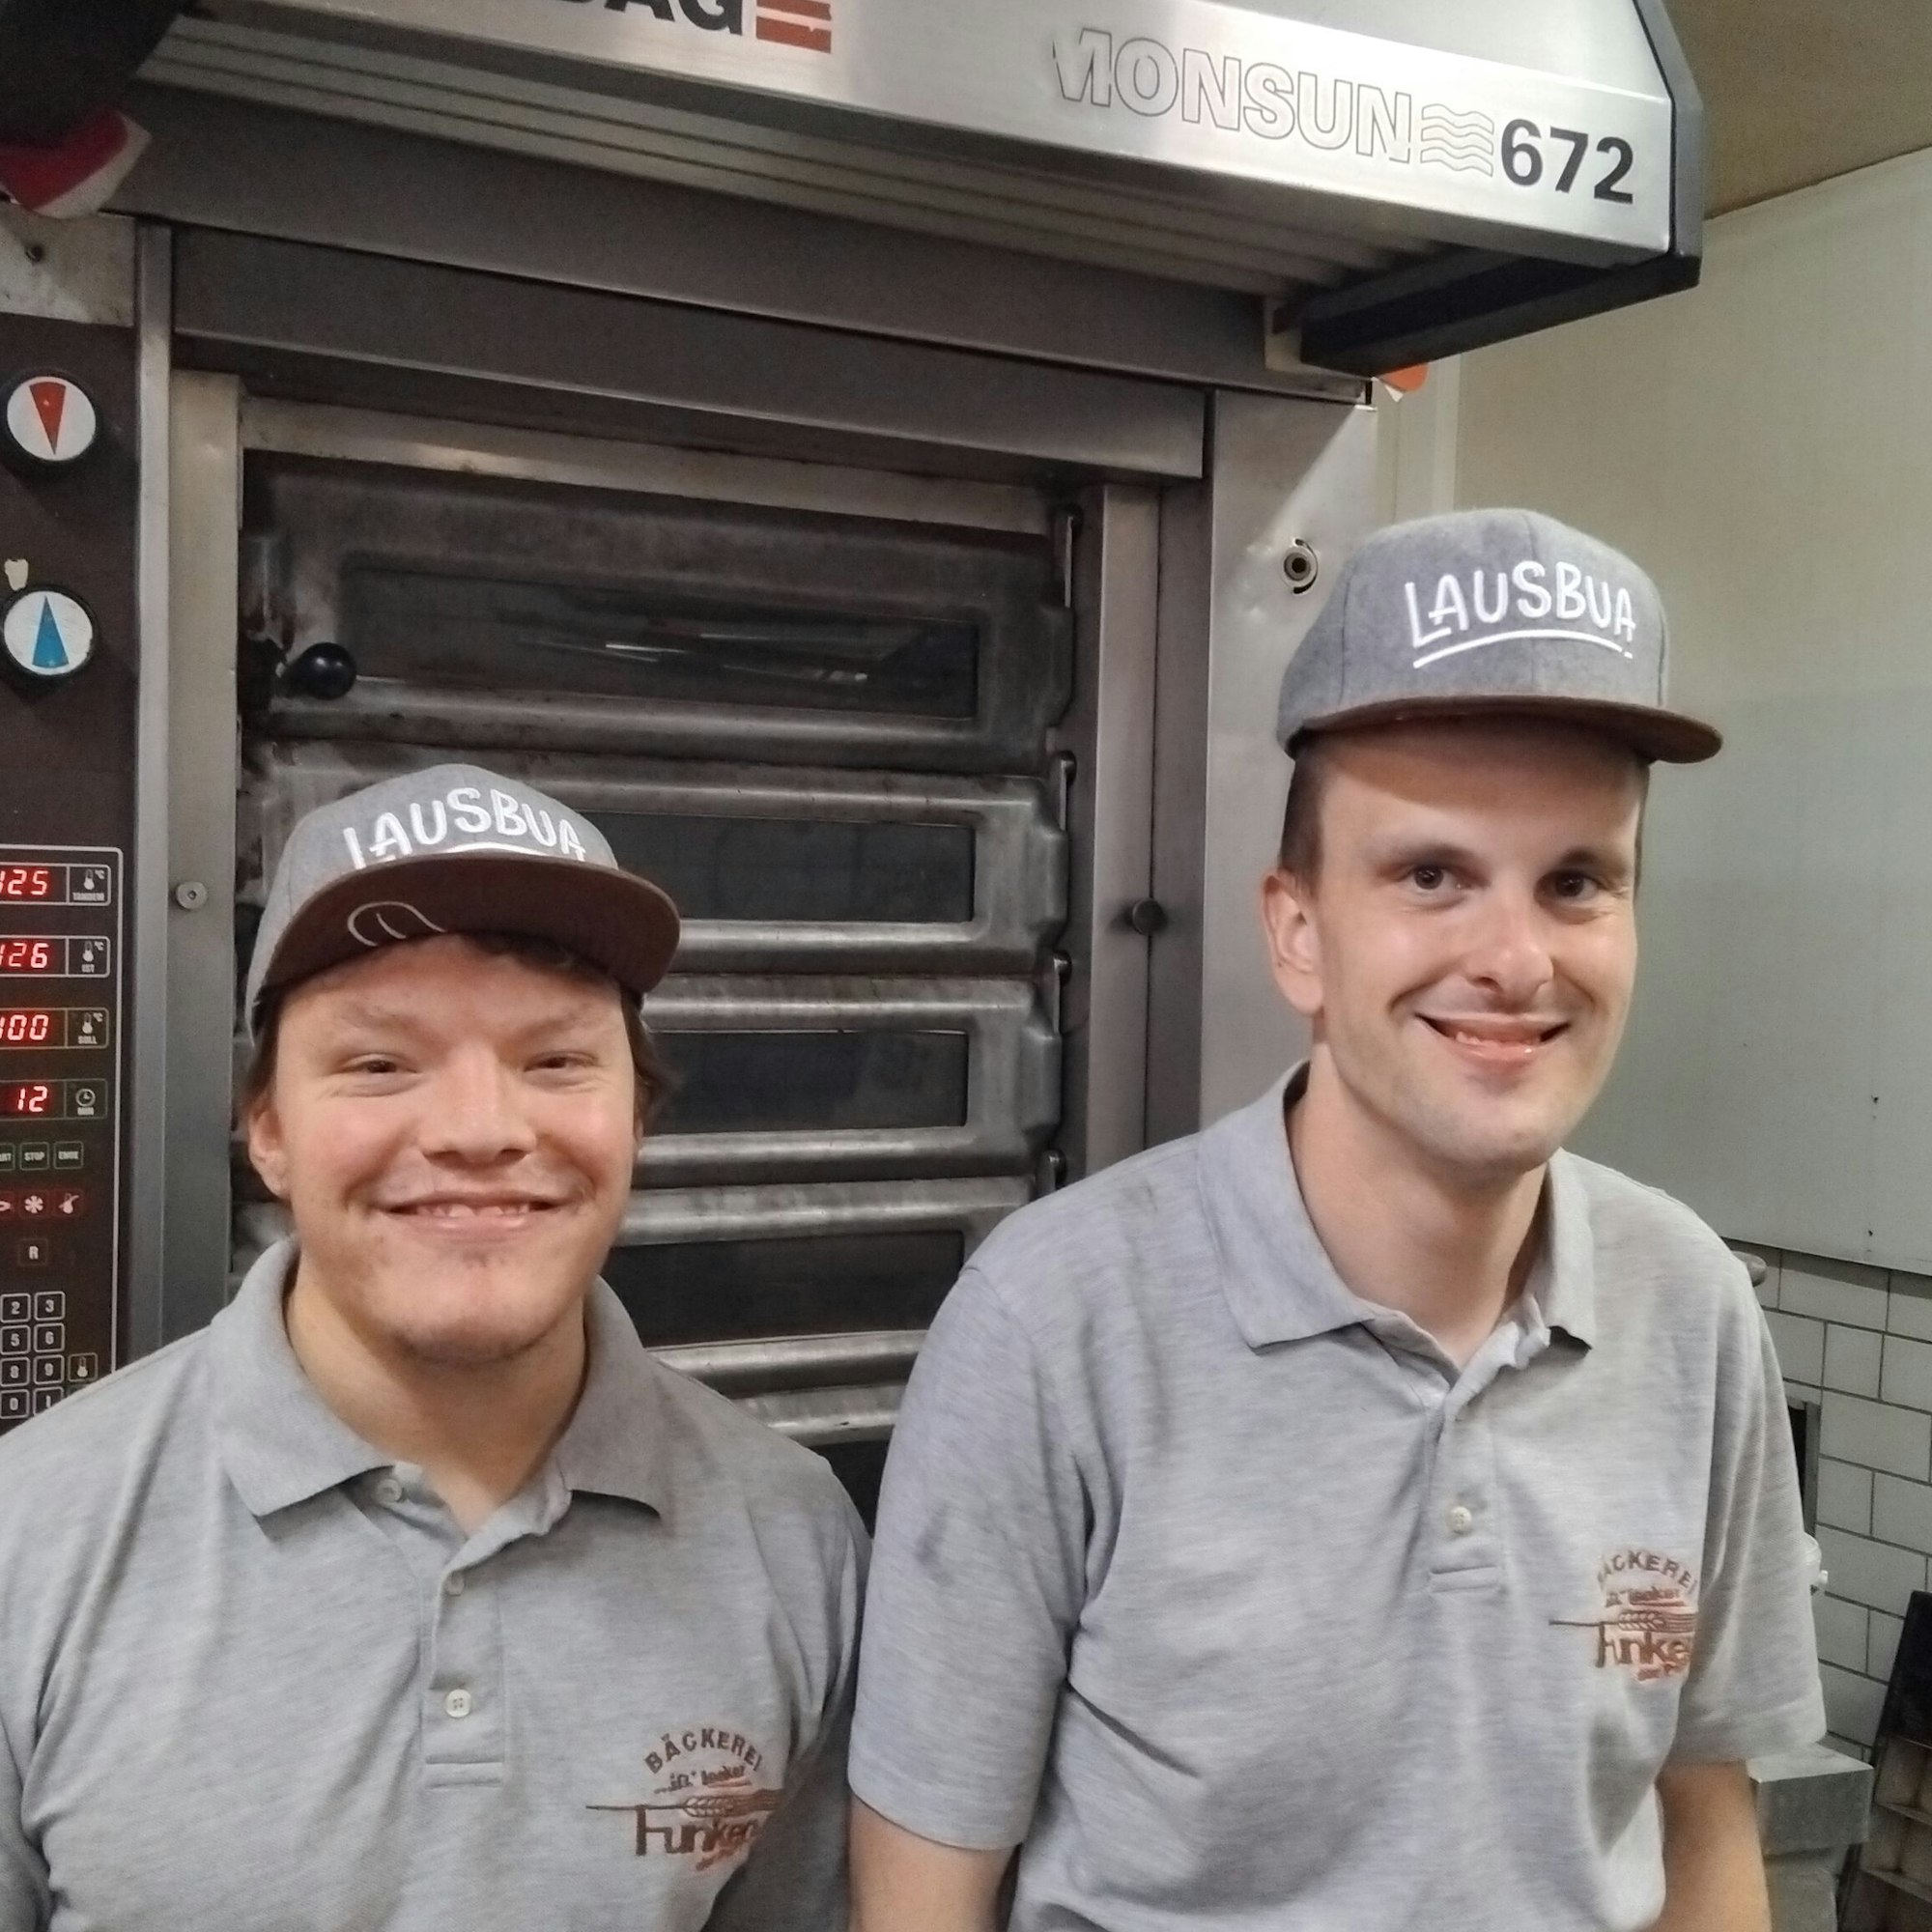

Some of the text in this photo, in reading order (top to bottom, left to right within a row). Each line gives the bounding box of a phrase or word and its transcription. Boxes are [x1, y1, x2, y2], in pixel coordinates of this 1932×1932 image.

[1052, 28, 1634, 204] MONSUN 672
[1405, 560, 1636, 648] LAUSBUA
[17, 1085, 48, 1113] 12
[29, 1245, 39, 1260] R
[11, 1301, 20, 1315] 2
[44, 1299, 54, 1313] 3
[11, 1333, 20, 1347] 5
[643, 1727, 763, 1774] BÄCKEREI
